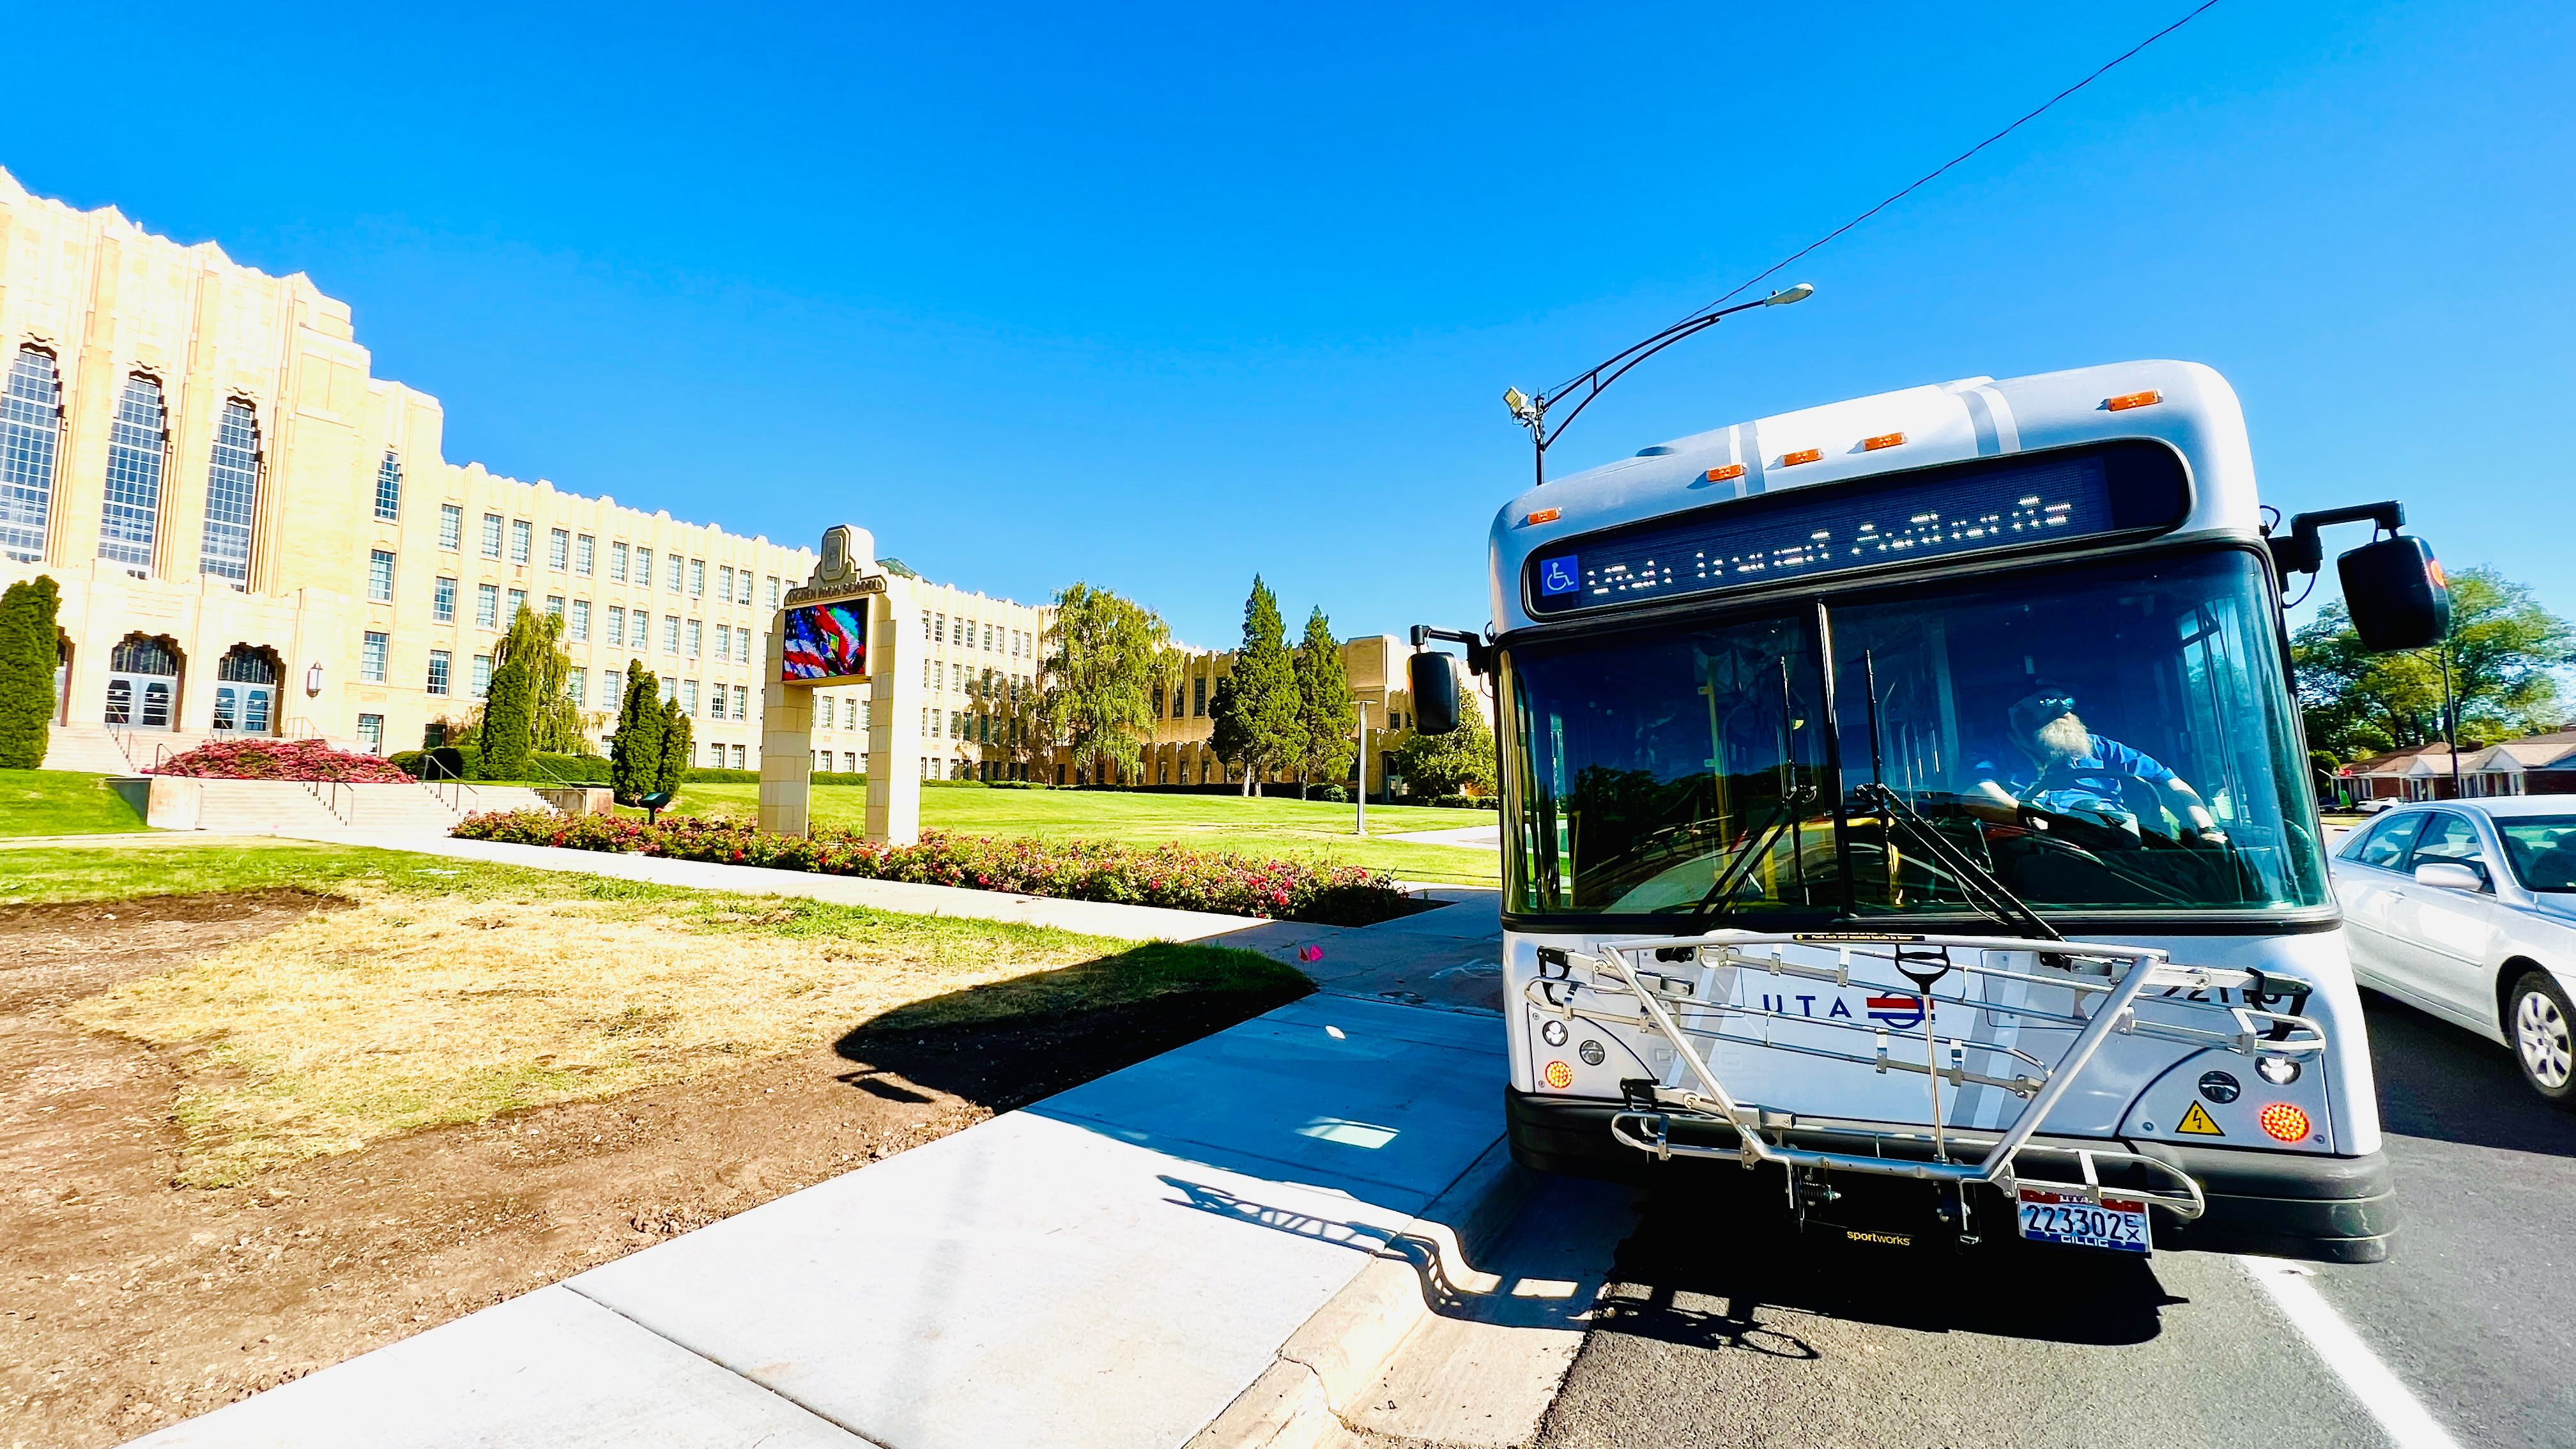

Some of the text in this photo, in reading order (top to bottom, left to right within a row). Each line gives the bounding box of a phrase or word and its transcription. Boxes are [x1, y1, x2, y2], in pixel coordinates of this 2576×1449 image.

[788, 578, 881, 604] OGDEN HIGH SCHOOL
[1762, 993, 1853, 1018] UTA
[2026, 1204, 2124, 1241] 223302
[1846, 1231, 1911, 1246] sportworks
[2060, 1234, 2109, 1248] GILLIG
